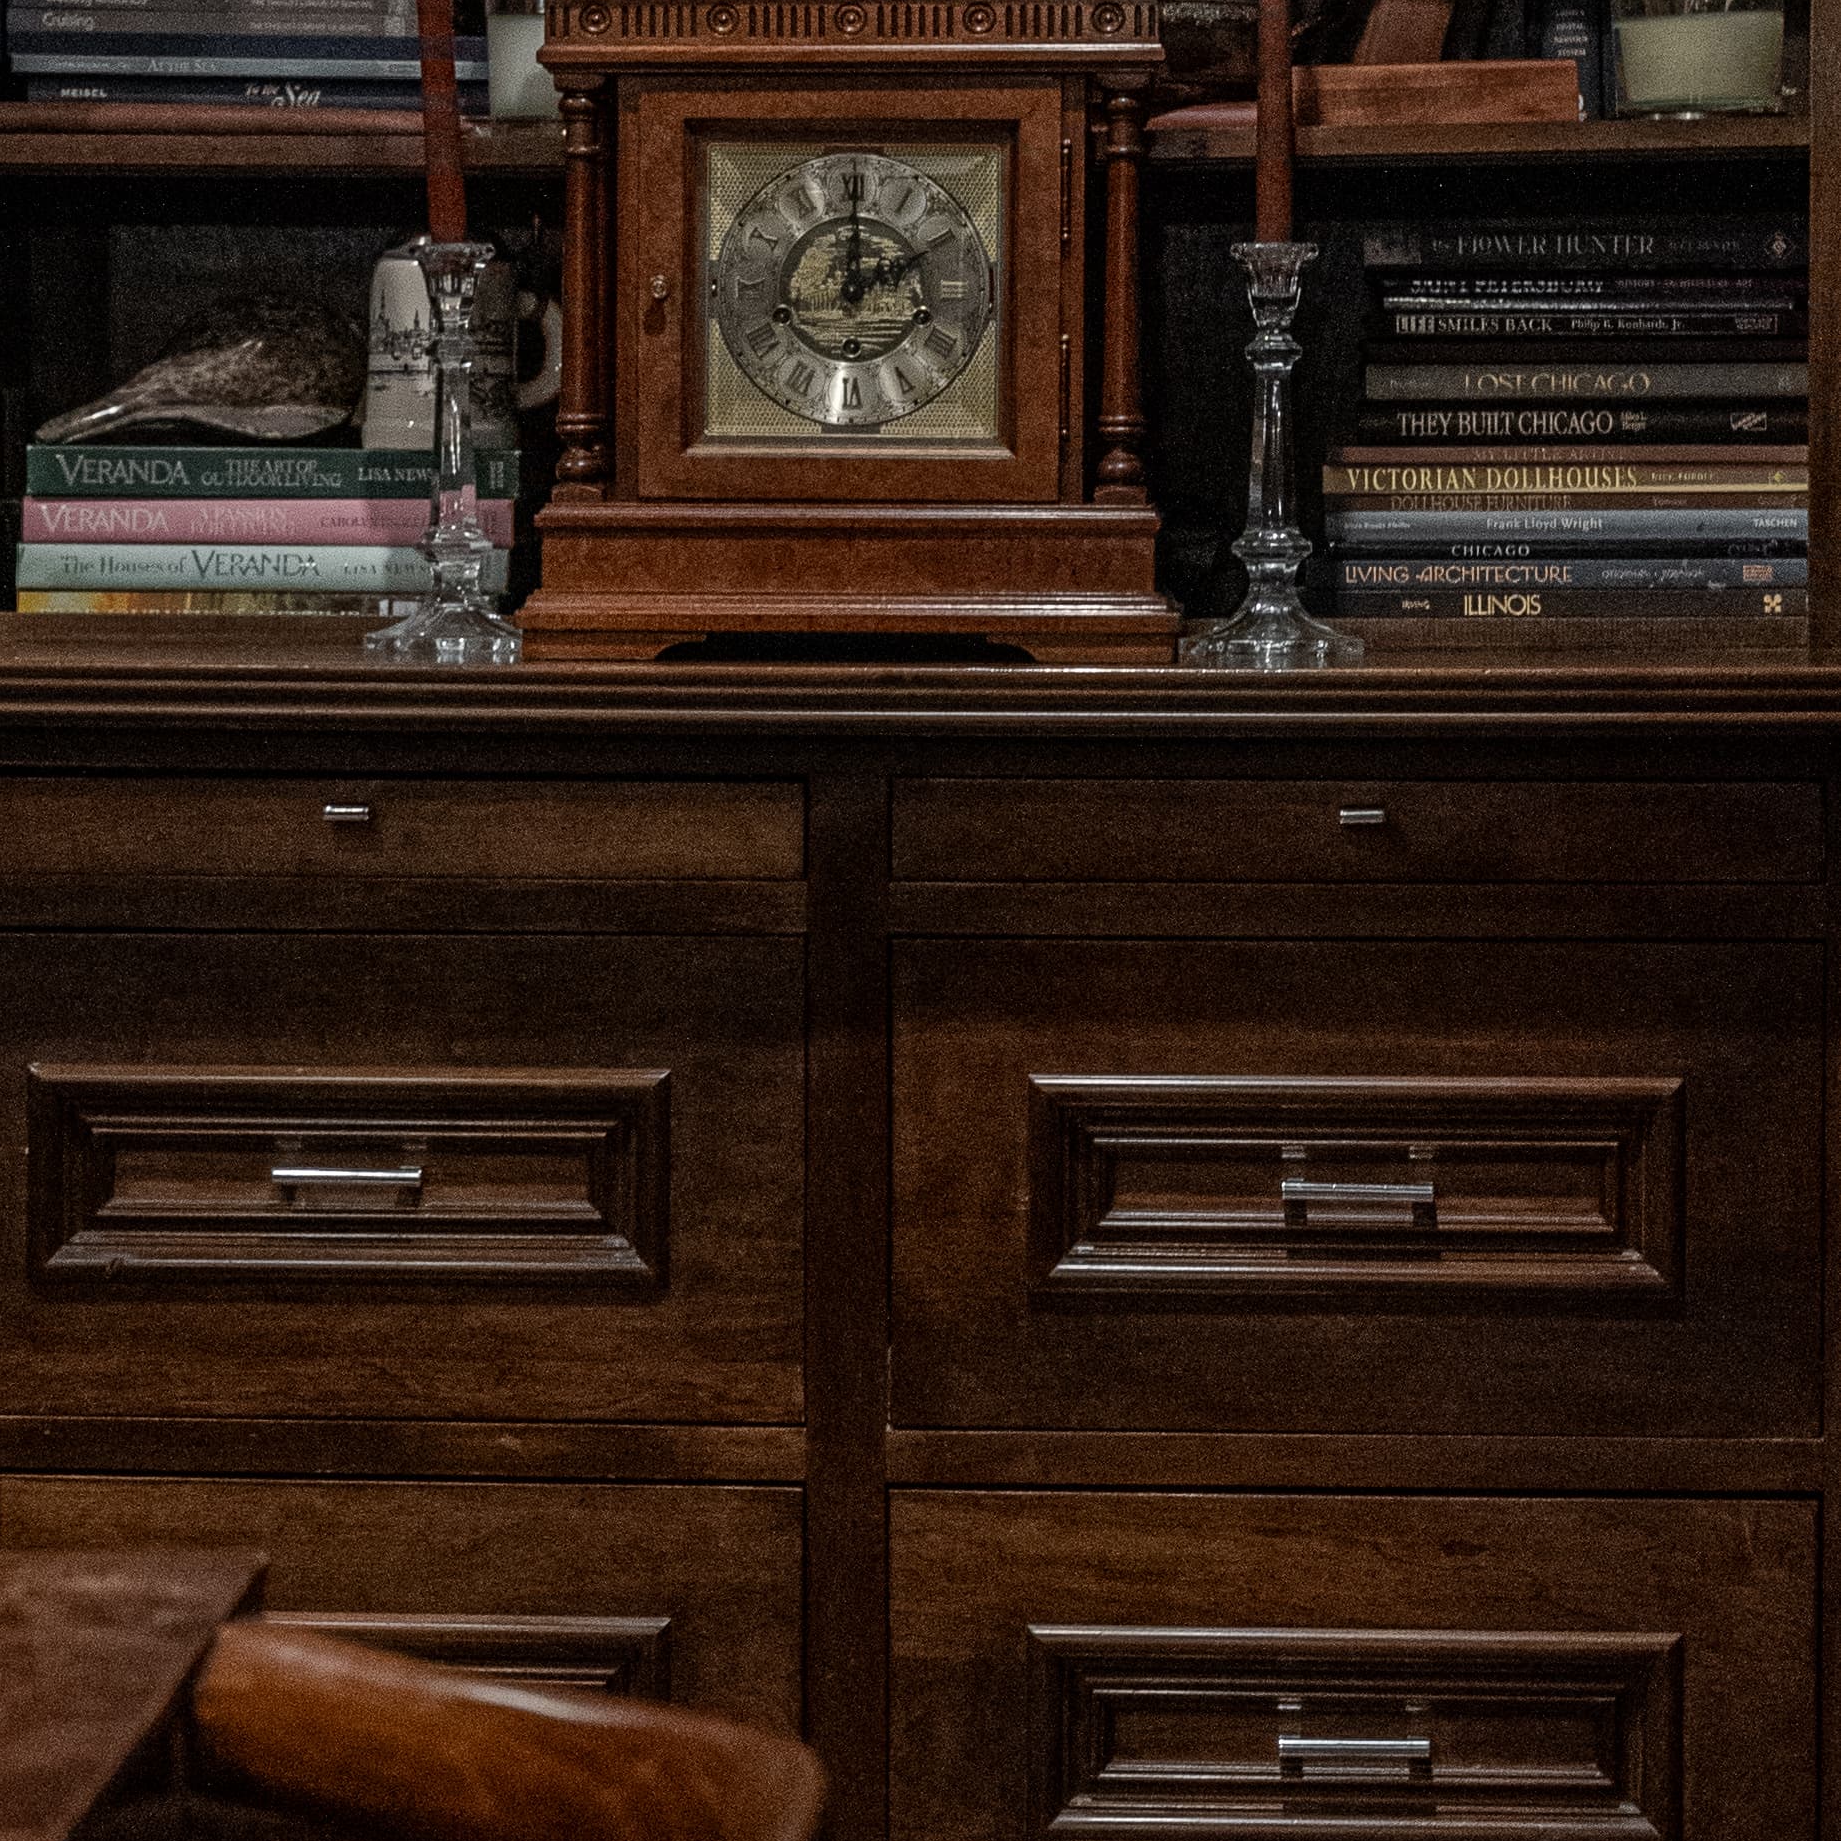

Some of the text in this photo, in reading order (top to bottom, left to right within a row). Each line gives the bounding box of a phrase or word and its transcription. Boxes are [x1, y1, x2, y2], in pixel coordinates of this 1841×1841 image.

[41, 11, 95, 32] Cruising
[60, 87, 108, 99] MEISEL
[1456, 236, 1547, 256] FLOWER
[1556, 235, 1655, 256] HUNTER
[1395, 314, 1553, 335] LIFE SMILES BACK
[1570, 317, 1686, 332] Philip Jr.
[1464, 372, 1651, 392] LOST CHICAGO
[842, 376, 862, 409] VI
[1396, 411, 1452, 436] THEY
[1458, 411, 1515, 436] BUILT
[1517, 411, 1614, 436] CHICAGO
[55, 453, 191, 486] VERANDA
[224, 458, 319, 473] THE ART OF
[357, 465, 389, 482] LISA
[200, 471, 343, 489] OUTDOOR LIVING
[1347, 465, 1638, 492] VICTORIAN DOLLHOUSES
[1390, 495, 1573, 511] DOLLHOUSE FURNITURE
[39, 502, 170, 534] VERANDA
[1485, 516, 1604, 534] Frank Lloyd Wright
[1751, 518, 1798, 528] TASCHEN
[1450, 544, 1531, 558] CHICAGO
[62, 549, 322, 578] The Houses of VERANDA
[1344, 565, 1573, 584] LIVING ARCHITECTURE
[1463, 593, 1542, 617] ILLINOIS
